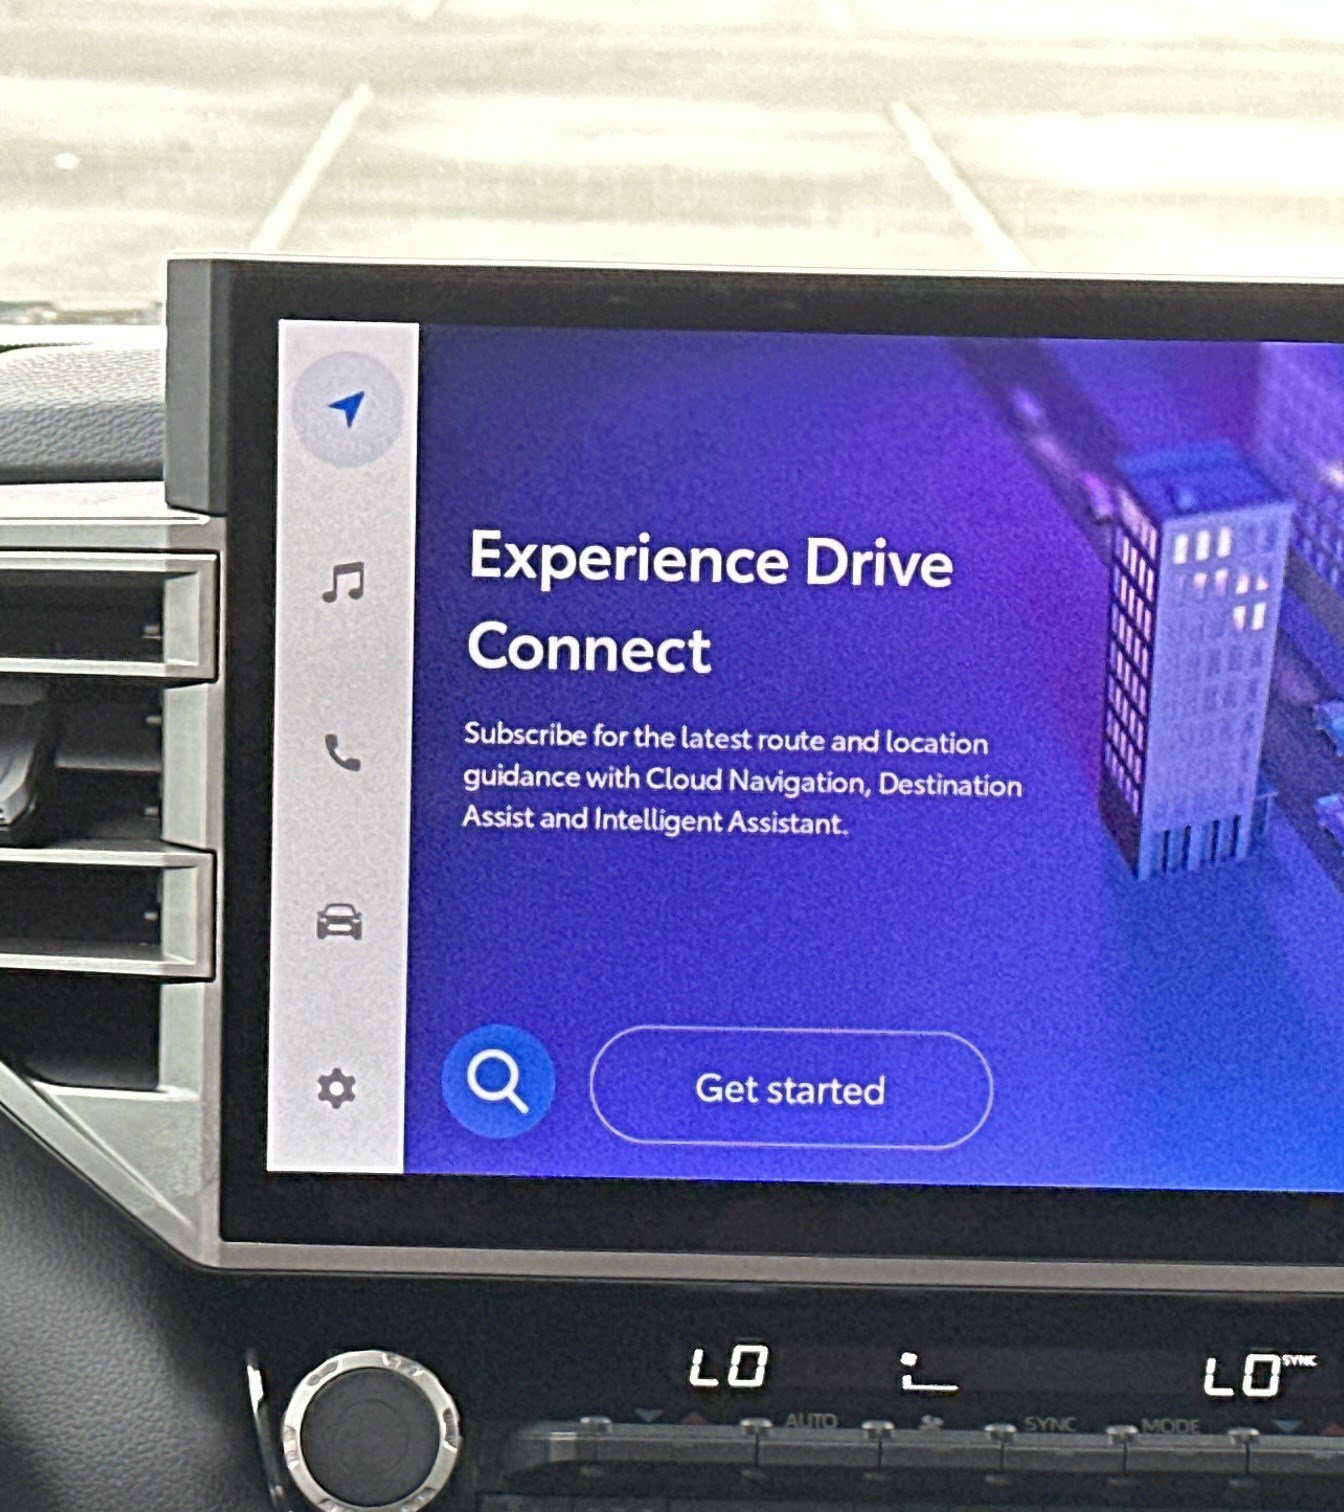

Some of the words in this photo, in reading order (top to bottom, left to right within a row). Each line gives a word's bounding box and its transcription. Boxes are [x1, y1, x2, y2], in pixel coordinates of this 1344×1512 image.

[469, 526, 788, 592] Experience
[806, 533, 954, 588] Drive
[467, 620, 712, 674] Connect
[464, 720, 587, 746] Subscribe
[593, 723, 629, 747] for
[634, 724, 676, 748] the
[681, 725, 752, 751] latest
[758, 730, 825, 752] route
[831, 729, 879, 753] and
[886, 729, 989, 756] location
[463, 762, 580, 791] guidance
[586, 764, 640, 790] with
[646, 766, 722, 791] Cloud
[729, 768, 871, 798] Navigation,
[879, 771, 1023, 797] Destination
[461, 804, 534, 829] Assist
[540, 806, 588, 830] and
[595, 806, 723, 837] Intelligent
[727, 809, 849, 836] Assistant.
[695, 1072, 760, 1104] Get
[767, 1074, 885, 1106] started
[1282, 1354, 1318, 1367] SYNC
[785, 1412, 837, 1429] AUTO
[1022, 1416, 1077, 1432] SYNC
[1140, 1418, 1200, 1434] MODE
